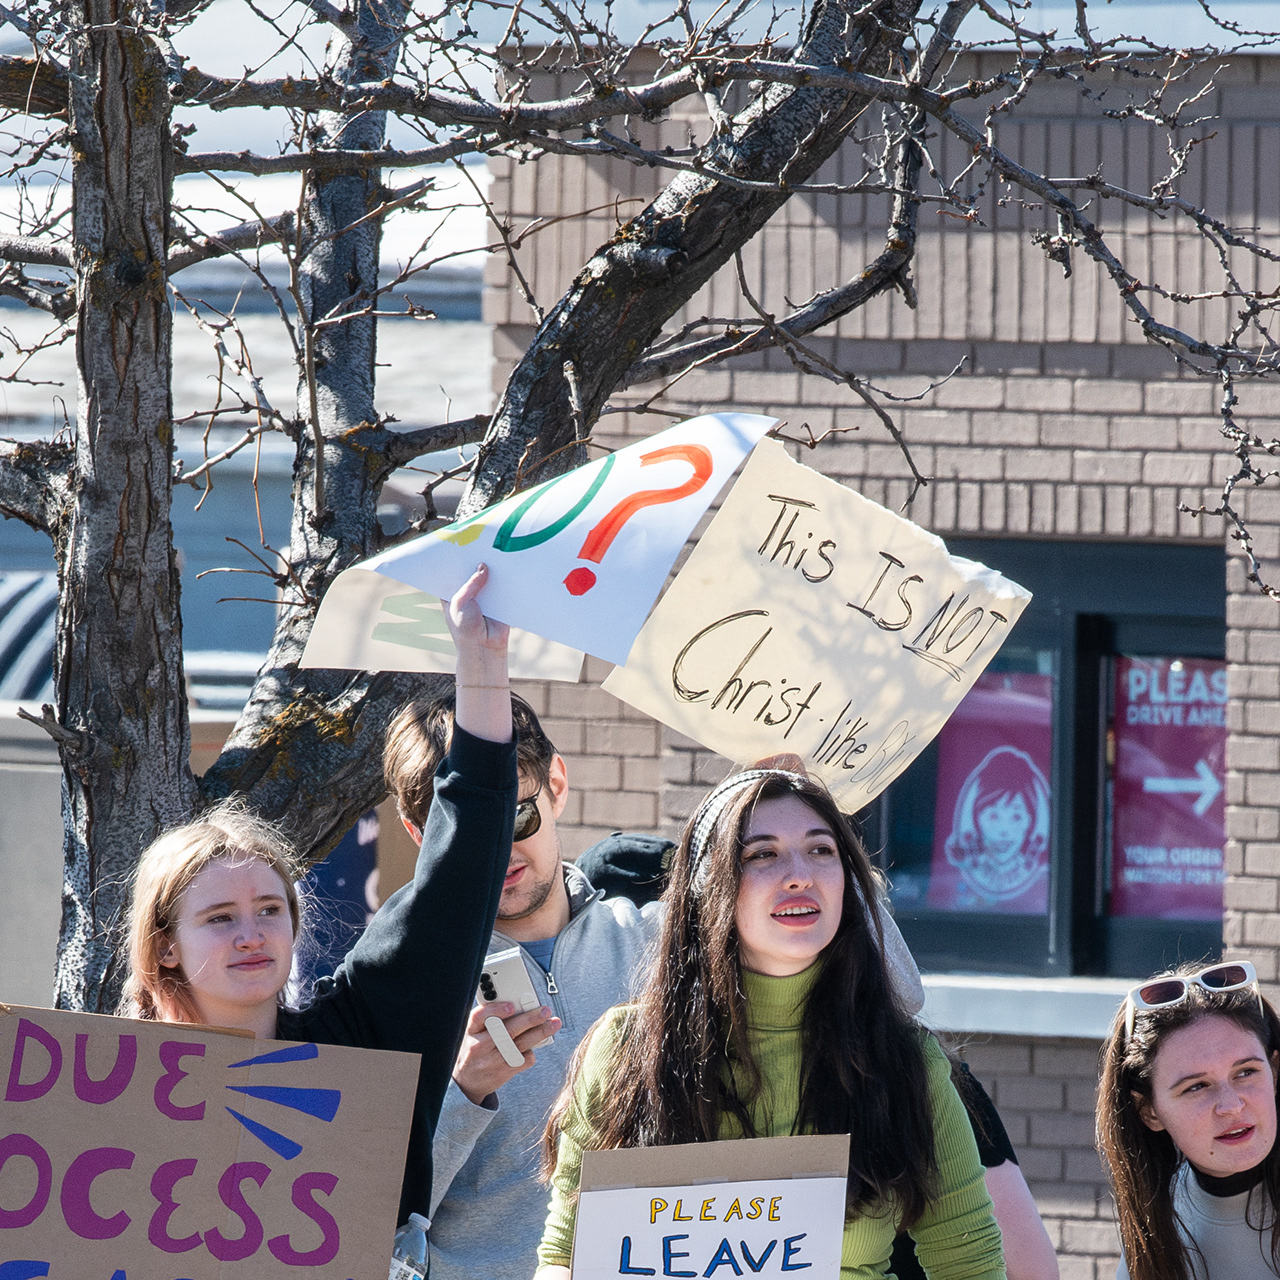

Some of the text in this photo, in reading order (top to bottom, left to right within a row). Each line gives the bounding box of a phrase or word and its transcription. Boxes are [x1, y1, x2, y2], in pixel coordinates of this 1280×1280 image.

[757, 493, 1008, 663] This IS NOT
[1127, 668, 1228, 703] PLEAS
[4, 1017, 206, 1121] DUE
[649, 1196, 783, 1224] PLEASE
[618, 1233, 813, 1279] LEAVE
